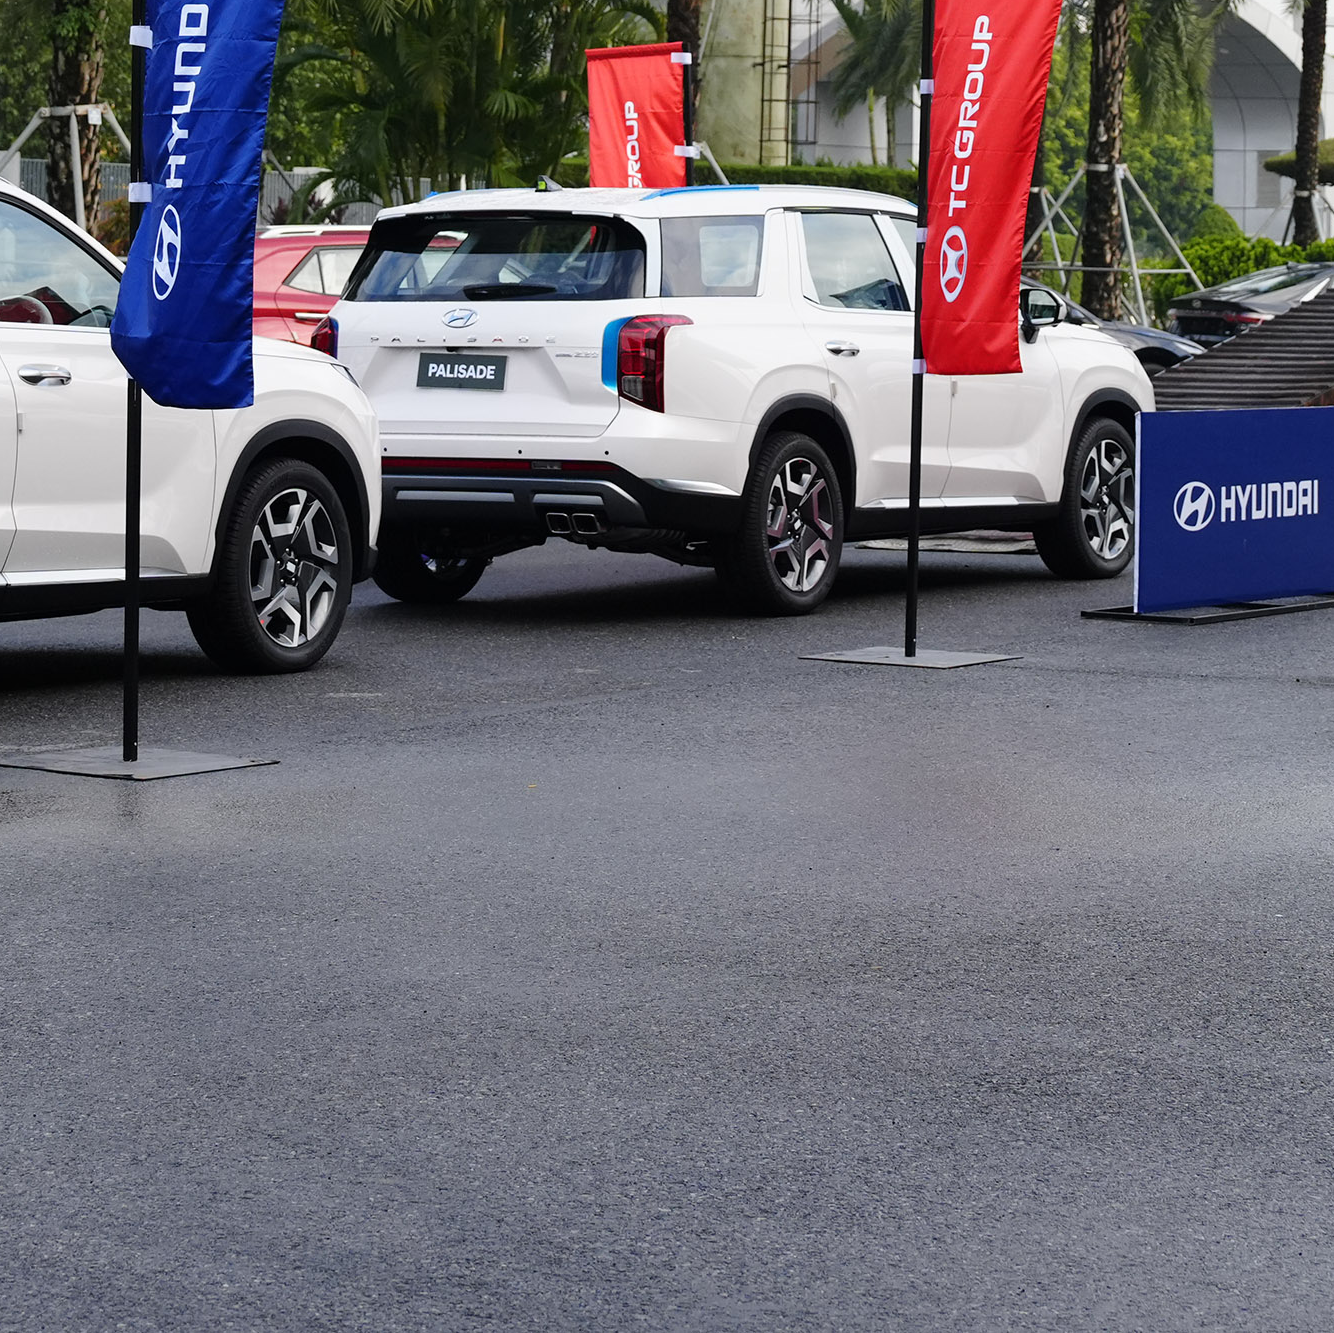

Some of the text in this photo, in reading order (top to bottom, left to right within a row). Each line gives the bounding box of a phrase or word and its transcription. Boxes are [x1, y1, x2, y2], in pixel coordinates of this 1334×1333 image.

[948, 15, 994, 217] TC GROUP
[428, 363, 496, 380] PALISADE
[1220, 479, 1319, 523] HYUNDAI
